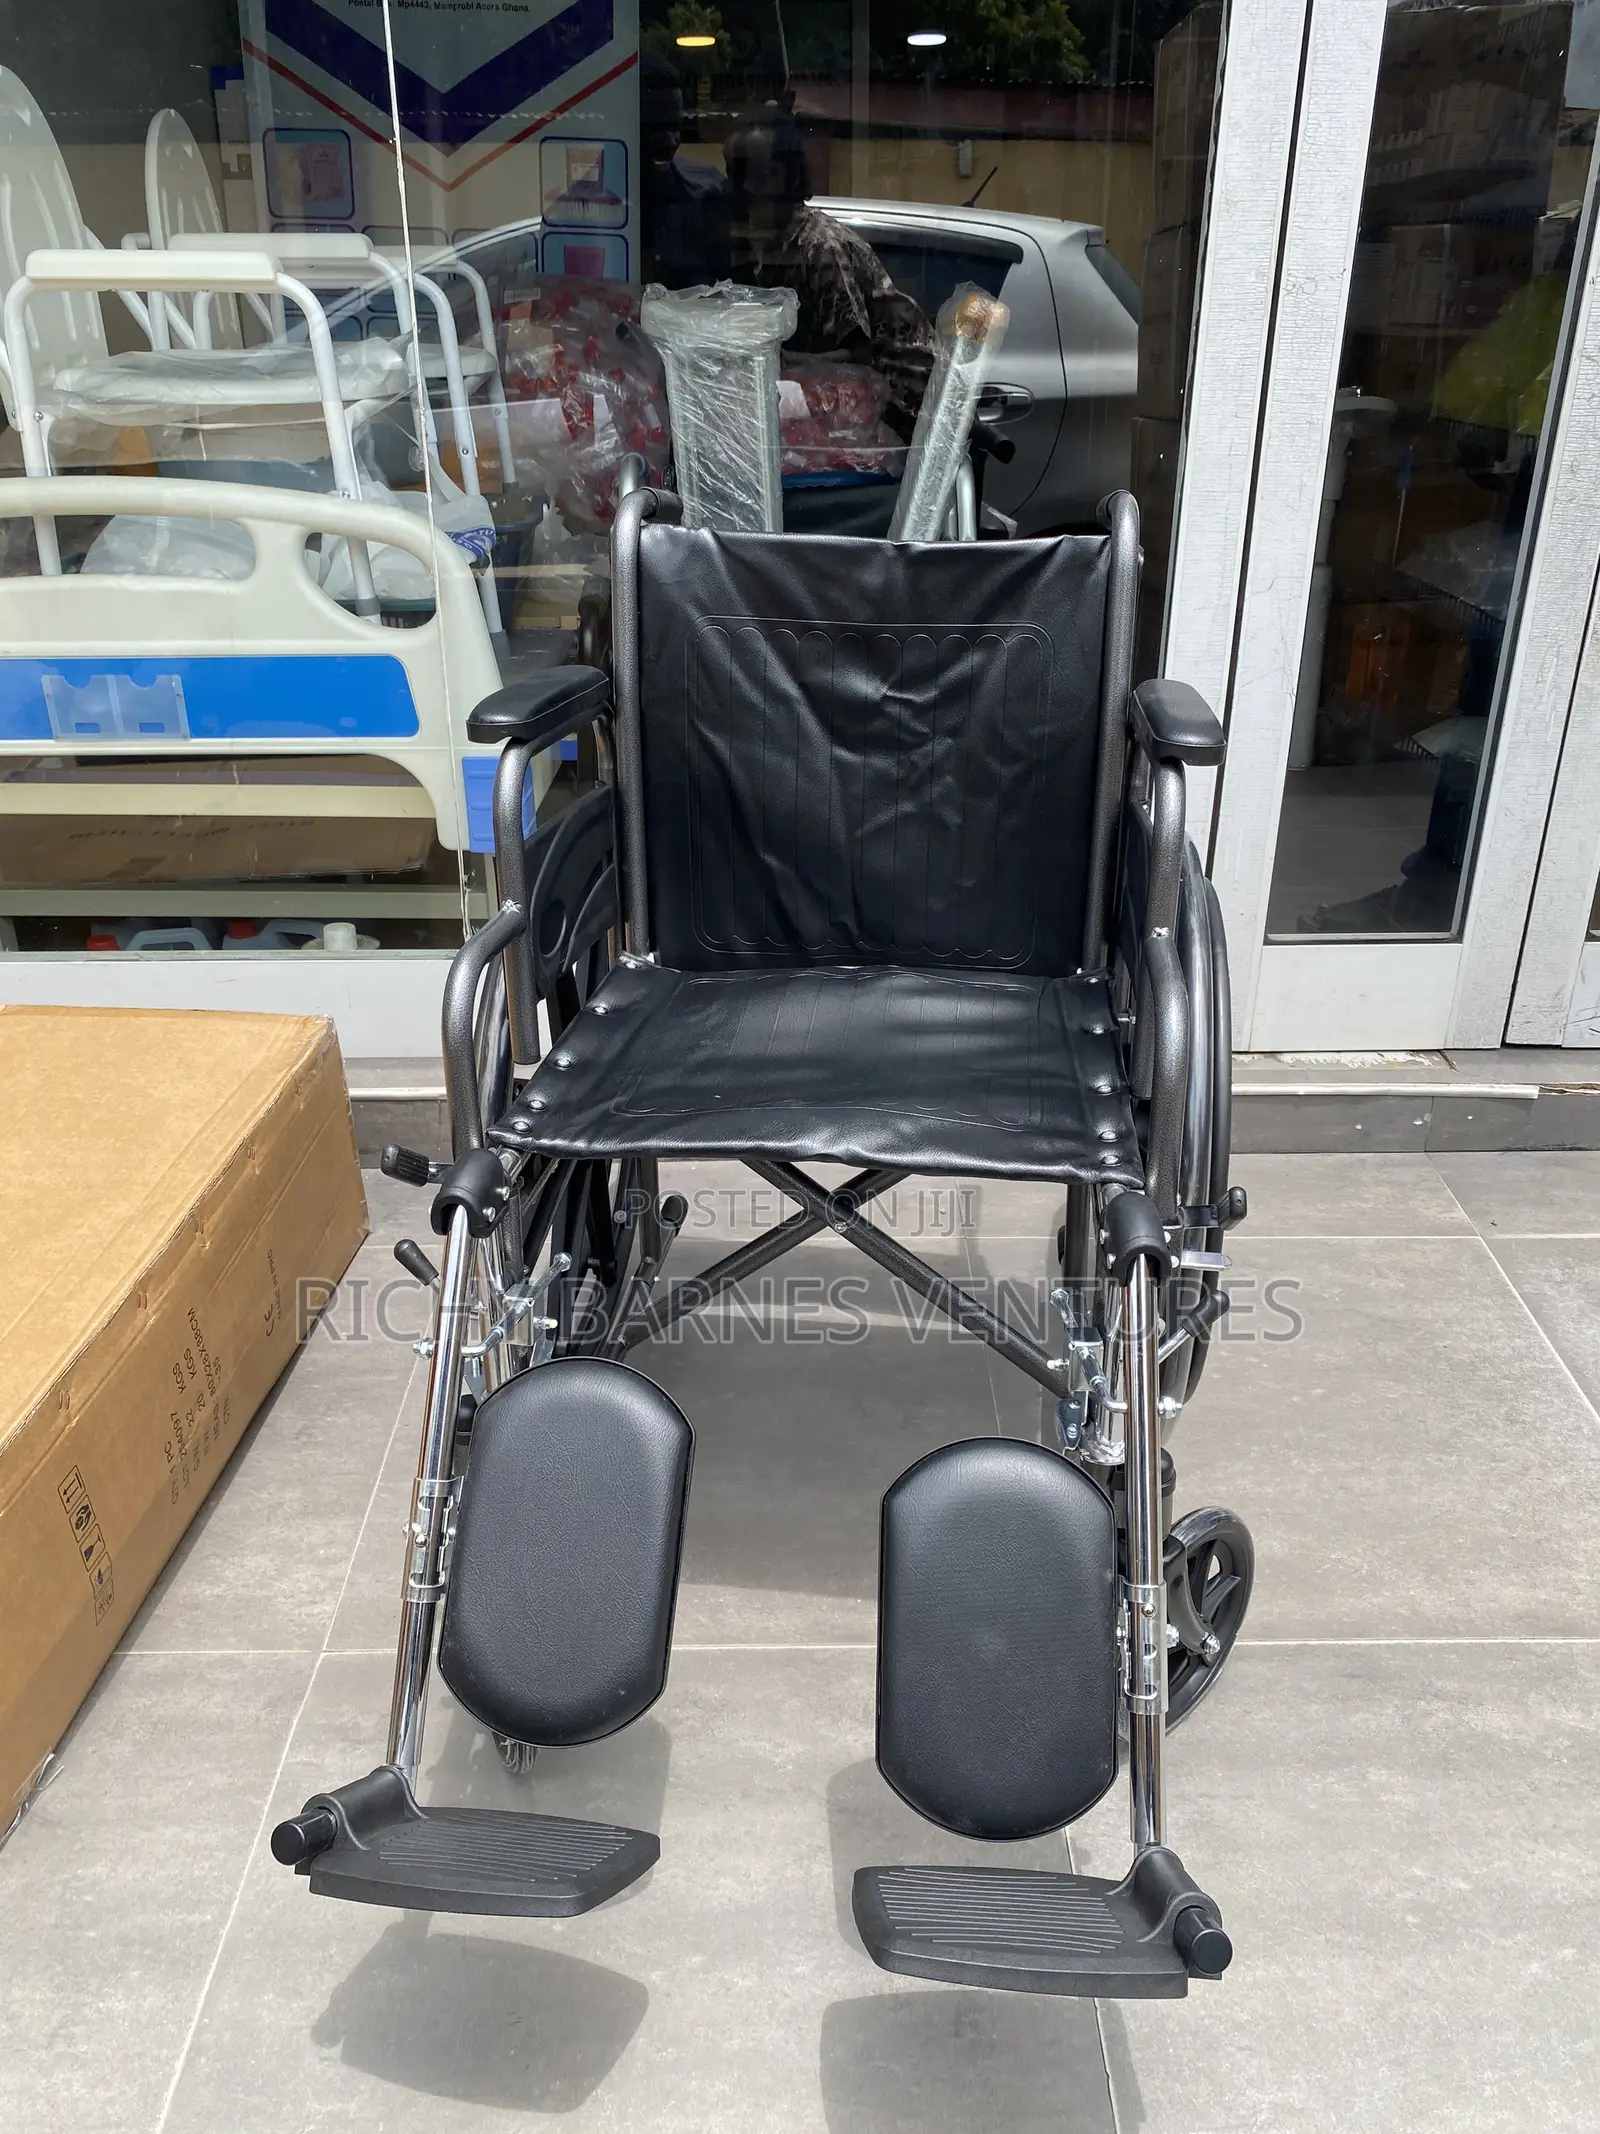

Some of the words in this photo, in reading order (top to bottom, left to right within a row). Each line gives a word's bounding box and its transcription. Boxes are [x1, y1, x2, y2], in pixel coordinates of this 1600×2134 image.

[183, 1347, 198, 1380] KGS
[172, 1362, 187, 1395] KGS
[196, 1392, 206, 1412] 20
[185, 1408, 195, 1428] 22
